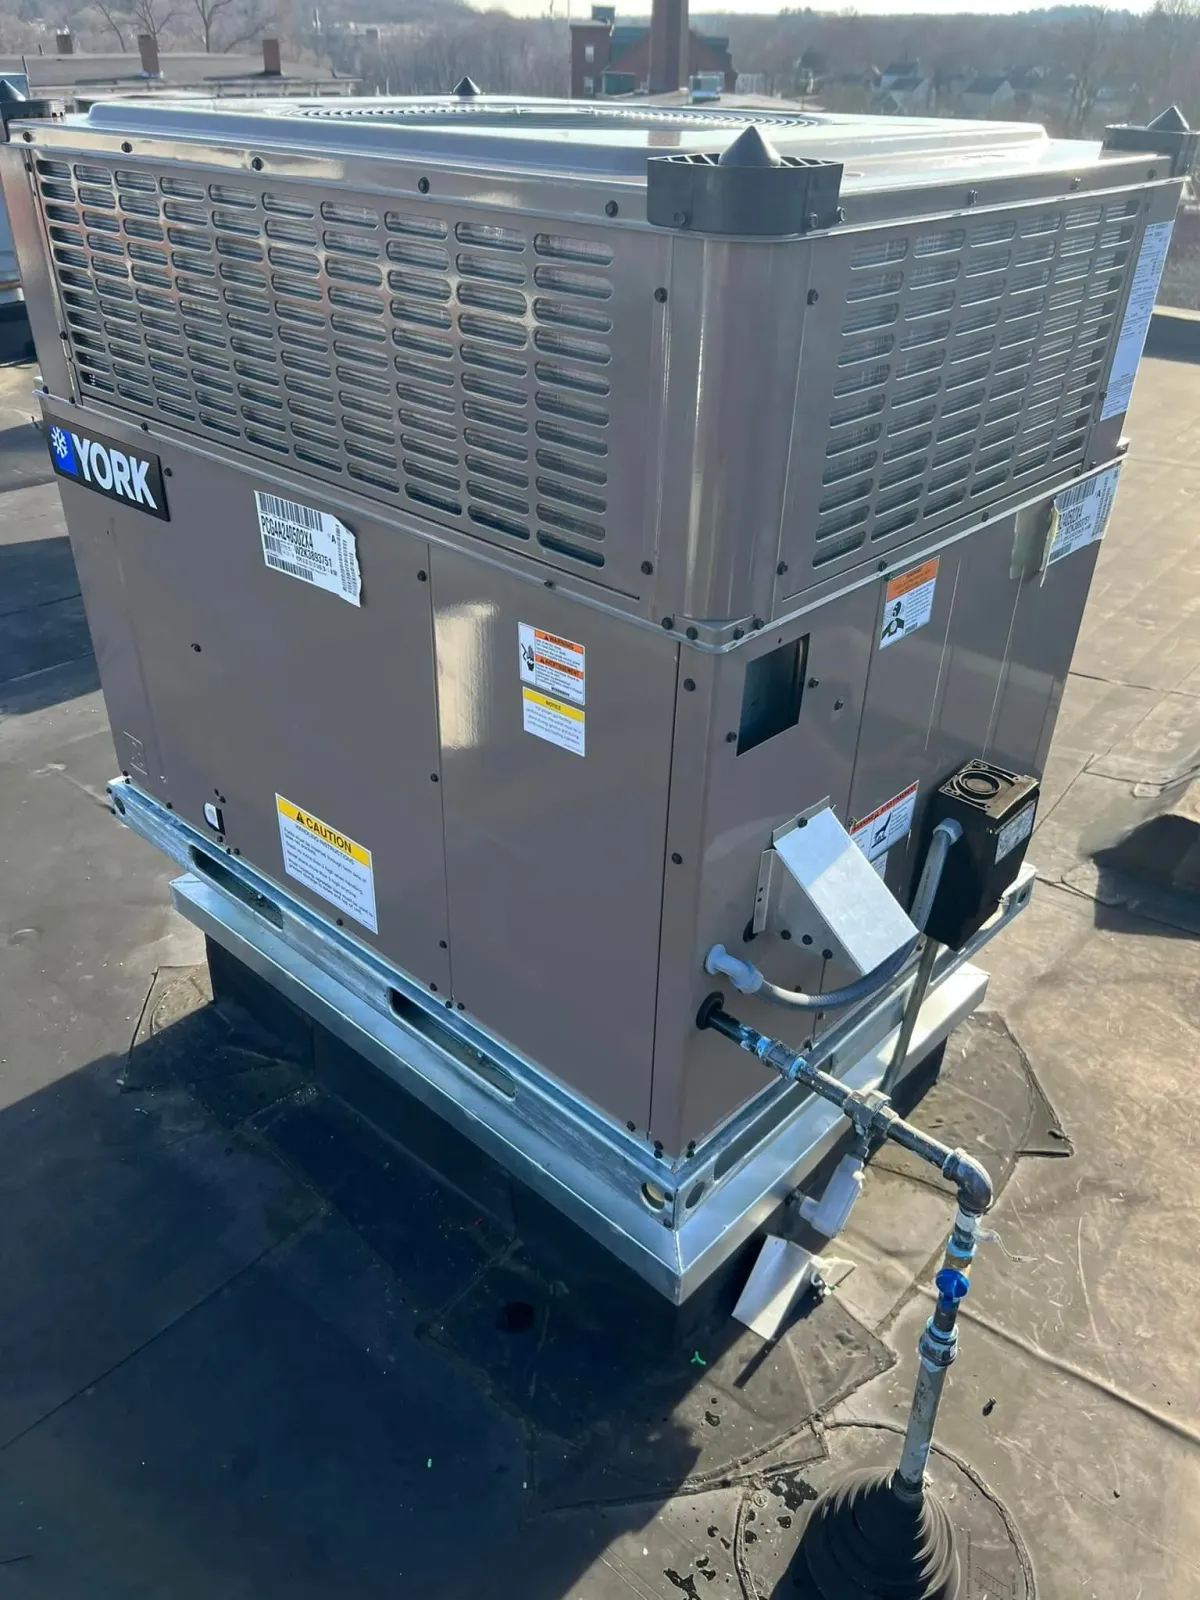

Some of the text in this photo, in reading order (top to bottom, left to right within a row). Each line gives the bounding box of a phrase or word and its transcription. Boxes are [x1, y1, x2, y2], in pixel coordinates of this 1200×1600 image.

[71, 433, 158, 510] YORK
[545, 699, 561, 711] NOTICE
[306, 817, 352, 854] CAUTION
